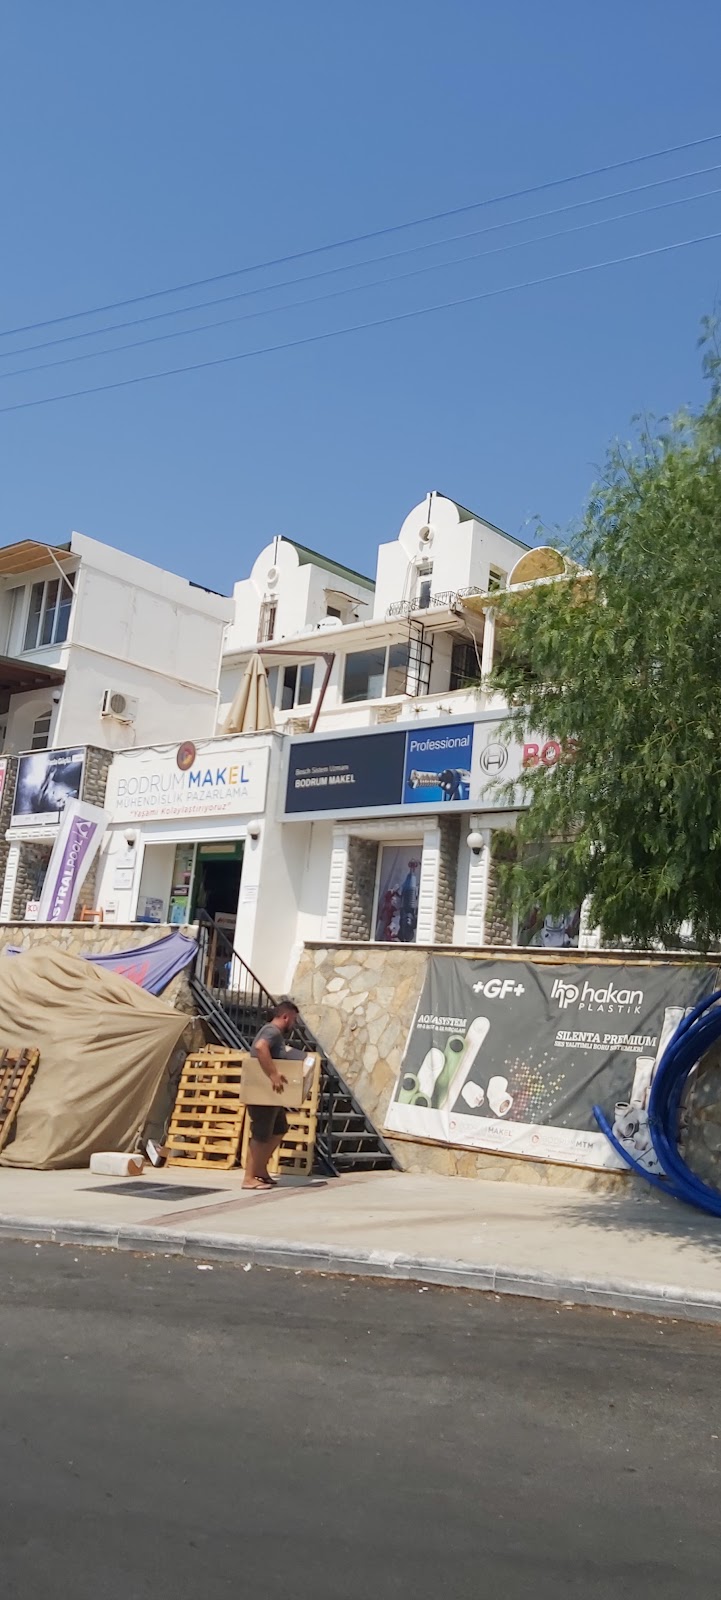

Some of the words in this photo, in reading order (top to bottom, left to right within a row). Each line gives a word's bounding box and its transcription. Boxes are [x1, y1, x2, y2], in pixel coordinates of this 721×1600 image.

[410, 734, 470, 752] Professional
[522, 737, 580, 768] BOS
[117, 773, 185, 797] BODRUM
[188, 765, 249, 788] MAKEL
[294, 777, 327, 788] BODRUM
[328, 774, 356, 785] MAKEL
[116, 793, 183, 809] MÜHENDİSLİK
[186, 787, 248, 802] PAZARLAMA
[50, 839, 83, 922] STRALPOOL
[581, 981, 644, 1005] hakan
[556, 1030, 601, 1043] SILENTA
[603, 1033, 657, 1047] PREMIUM
[487, 1126, 512, 1137] MAKEL
[575, 1140, 594, 1149] MTM
